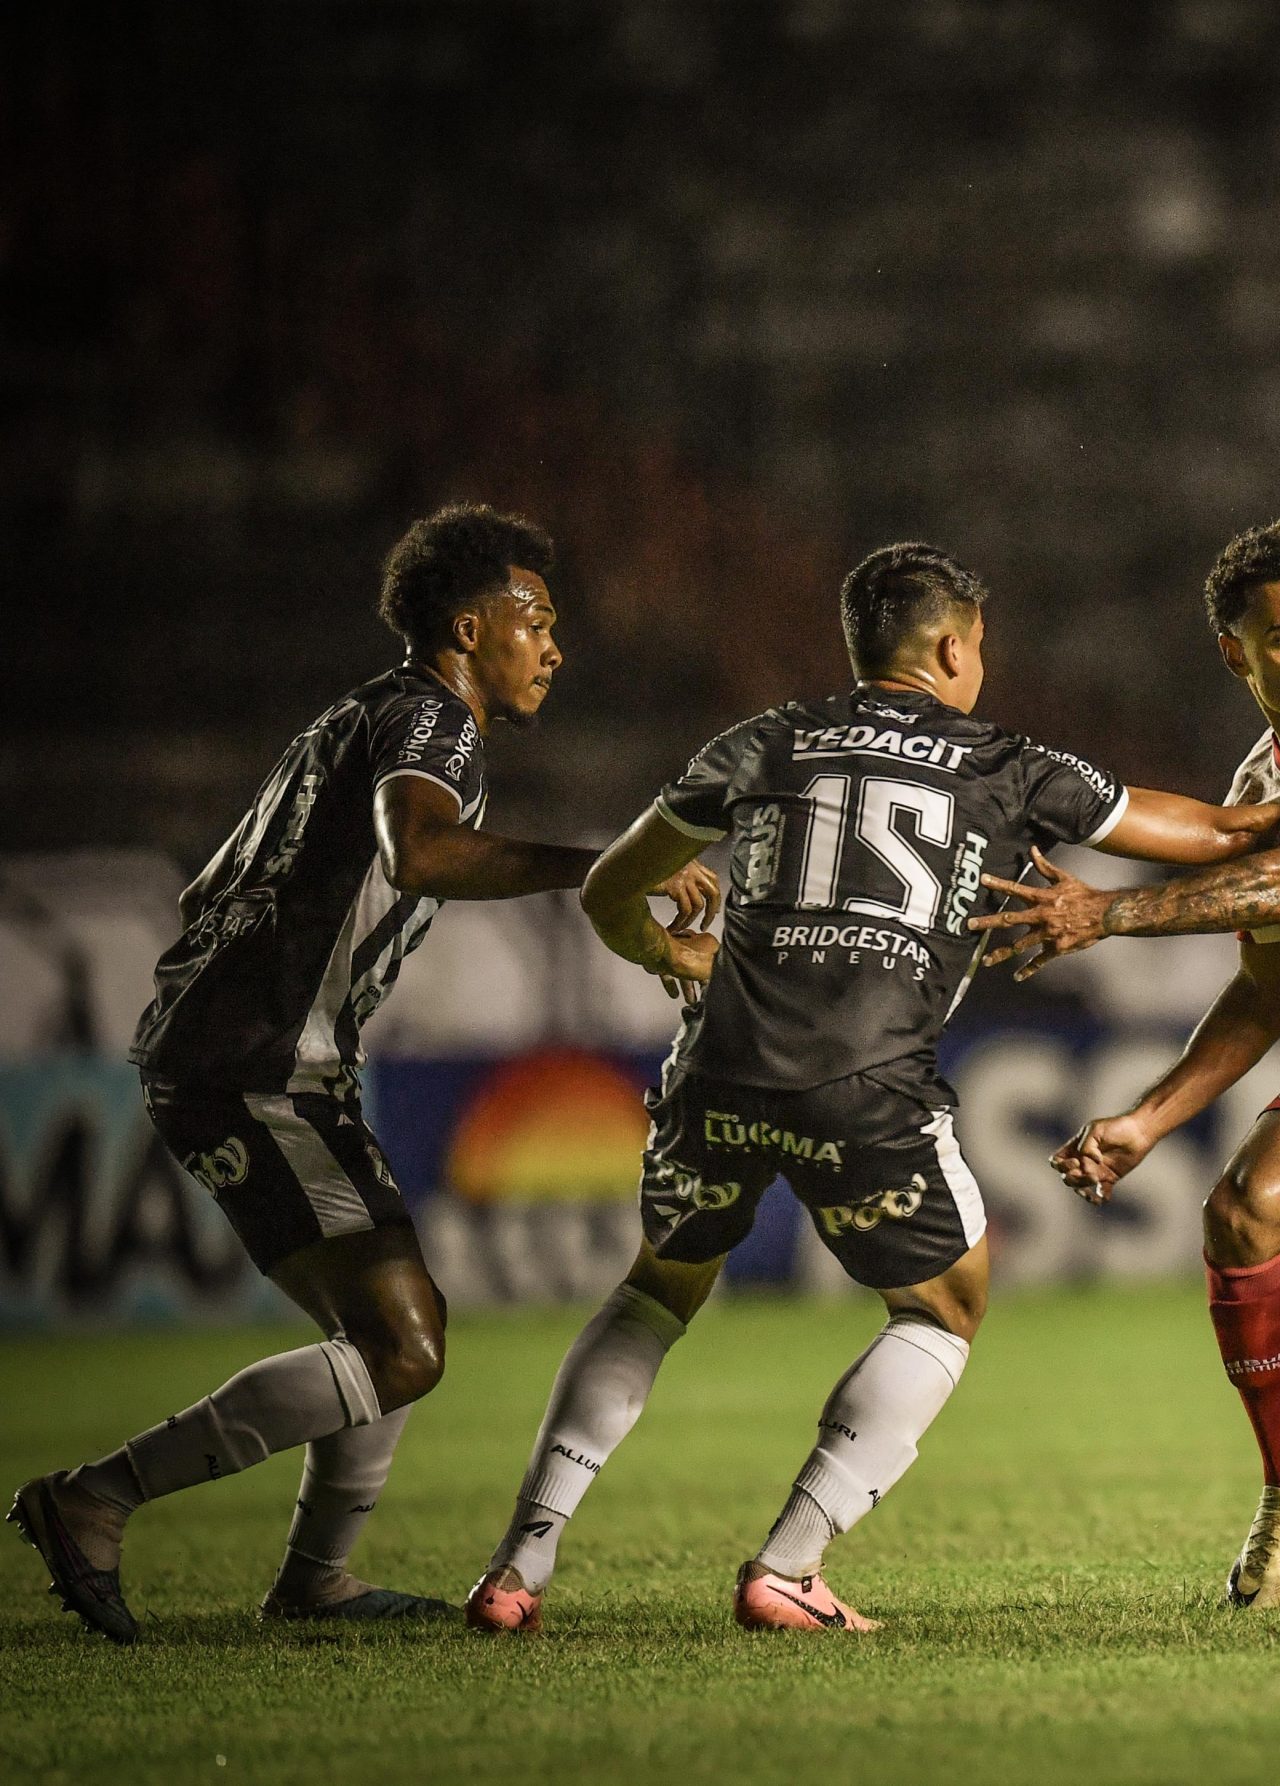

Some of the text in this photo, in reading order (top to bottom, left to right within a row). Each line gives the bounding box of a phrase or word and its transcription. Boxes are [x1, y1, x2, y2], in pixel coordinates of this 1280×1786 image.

[402, 711, 440, 763] KRONA
[793, 725, 973, 770] VEDACIT
[1046, 749, 1115, 800] KRONA
[794, 773, 956, 935] 15
[945, 830, 989, 936] HAUS
[771, 925, 931, 969] BRIDGESTAR
[777, 950, 926, 982] PNEUS
